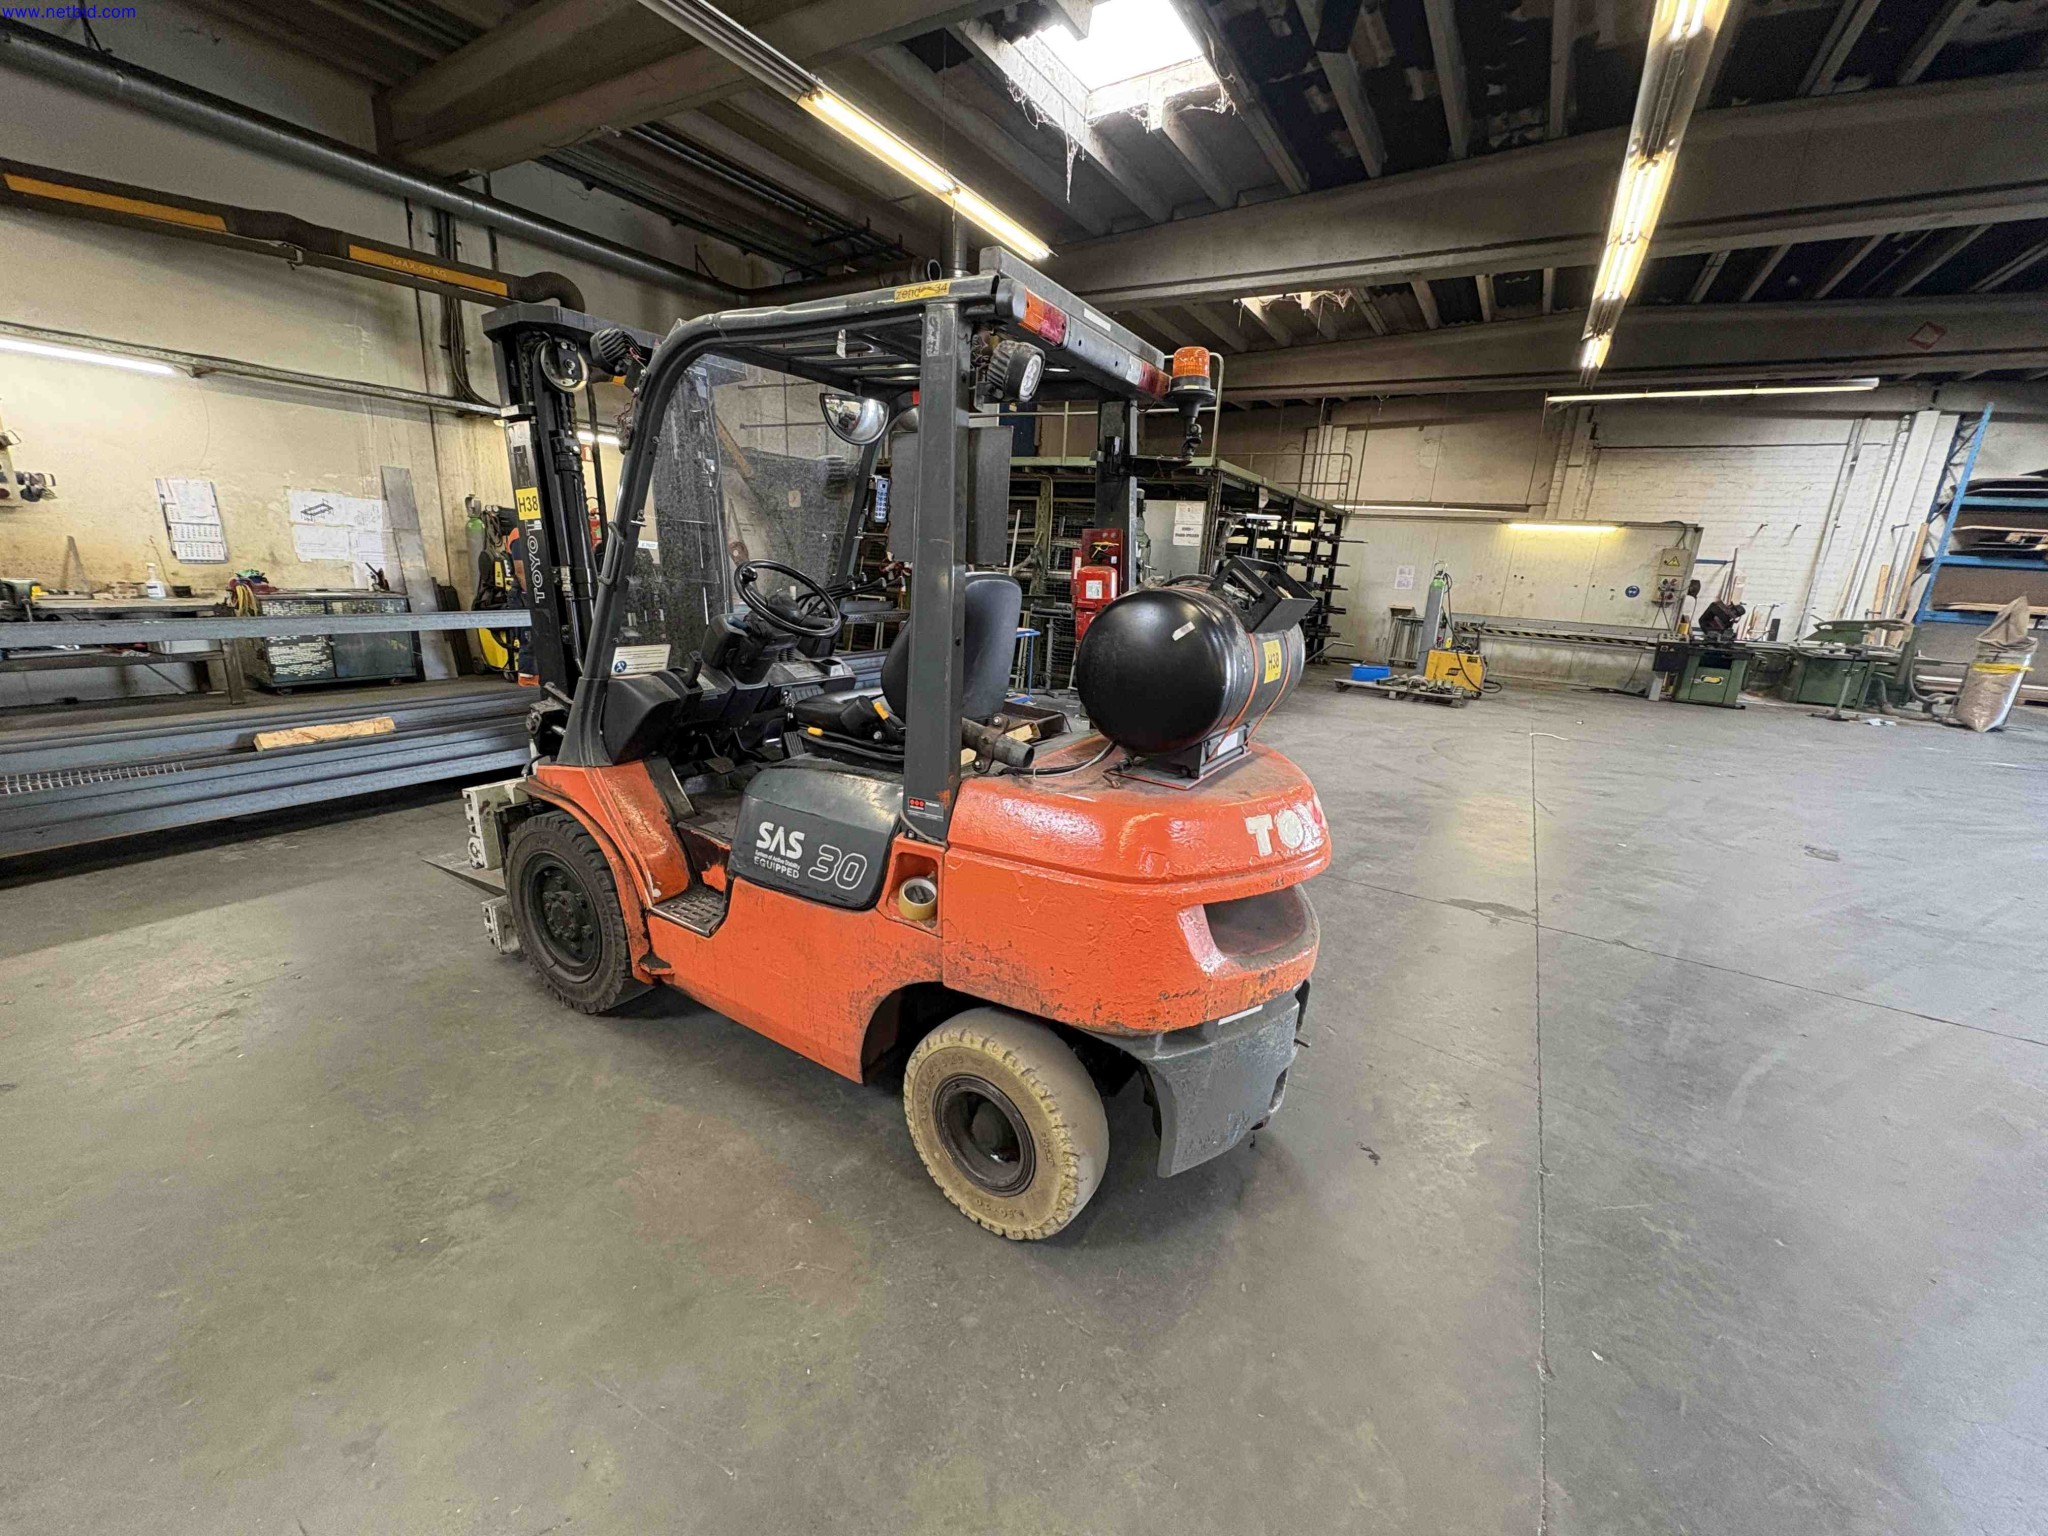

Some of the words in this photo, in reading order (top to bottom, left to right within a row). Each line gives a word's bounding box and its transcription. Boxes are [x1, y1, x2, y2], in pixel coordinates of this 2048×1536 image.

[518, 495, 539, 514] H38
[524, 518, 546, 604] TOYOT
[1267, 652, 1280, 670] H38
[756, 821, 805, 860] SAS
[753, 856, 800, 879] EQUIPPED
[807, 844, 868, 890] 30
